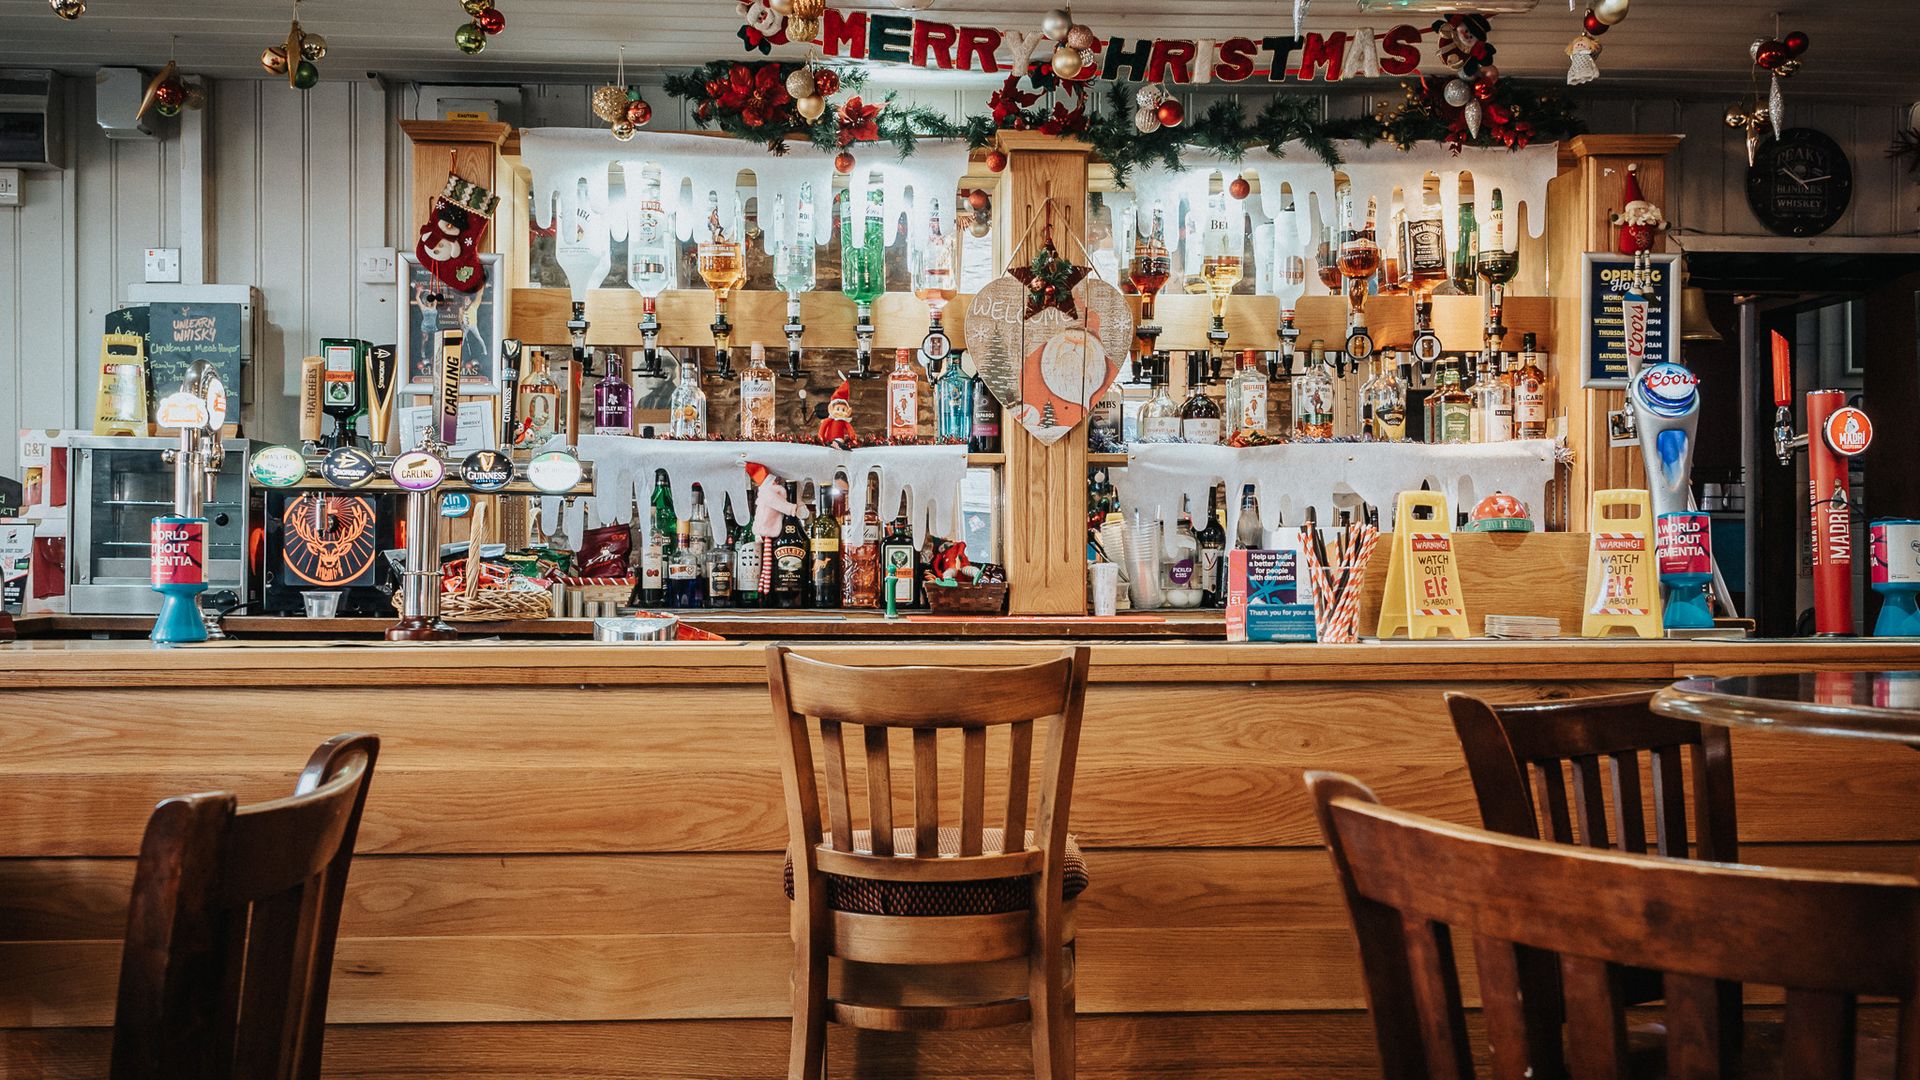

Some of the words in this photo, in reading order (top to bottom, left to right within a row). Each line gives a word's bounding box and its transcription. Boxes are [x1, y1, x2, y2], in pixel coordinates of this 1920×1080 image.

[822, 8, 1042, 77] MERRY
[1776, 184, 1823, 194] BLINDERS
[1776, 199, 1822, 208] WHISKEY
[1600, 269, 1662, 282] OPENG
[172, 316, 216, 330] UNLEARN
[173, 328, 217, 342] WHISKY
[1628, 304, 1644, 357] Coors
[1643, 371, 1698, 389] Coors
[444, 355, 460, 417] CARLING
[305, 366, 318, 419] THATCHERS
[503, 387, 513, 423] GUINNESS
[1839, 431, 1866, 445] MADRÍ
[23, 443, 47, 457] G&T
[333, 467, 367, 477] STRONGBOW
[401, 469, 434, 479] CARLING
[467, 471, 508, 480] GUINNESS
[1811, 515, 1817, 527] DE
[1825, 508, 1850, 559] MADRÍ
[1415, 540, 1448, 550] WARNING!
[1599, 539, 1640, 549] WARNING!
[776, 548, 804, 557] BAILEYS
[1251, 553, 1267, 561] Help
[1418, 554, 1449, 565] WATCH
[1600, 553, 1639, 564] WATCH
[1812, 558, 1819, 566] EL
[1424, 564, 1446, 576] OUT!
[1607, 565, 1632, 576] OUT!
[1424, 576, 1448, 598] Elf
[1606, 575, 1634, 598] Elf
[1231, 596, 1241, 605] £1
[1431, 598, 1454, 606] ABOUT!
[1608, 597, 1638, 606] ABOUT!
